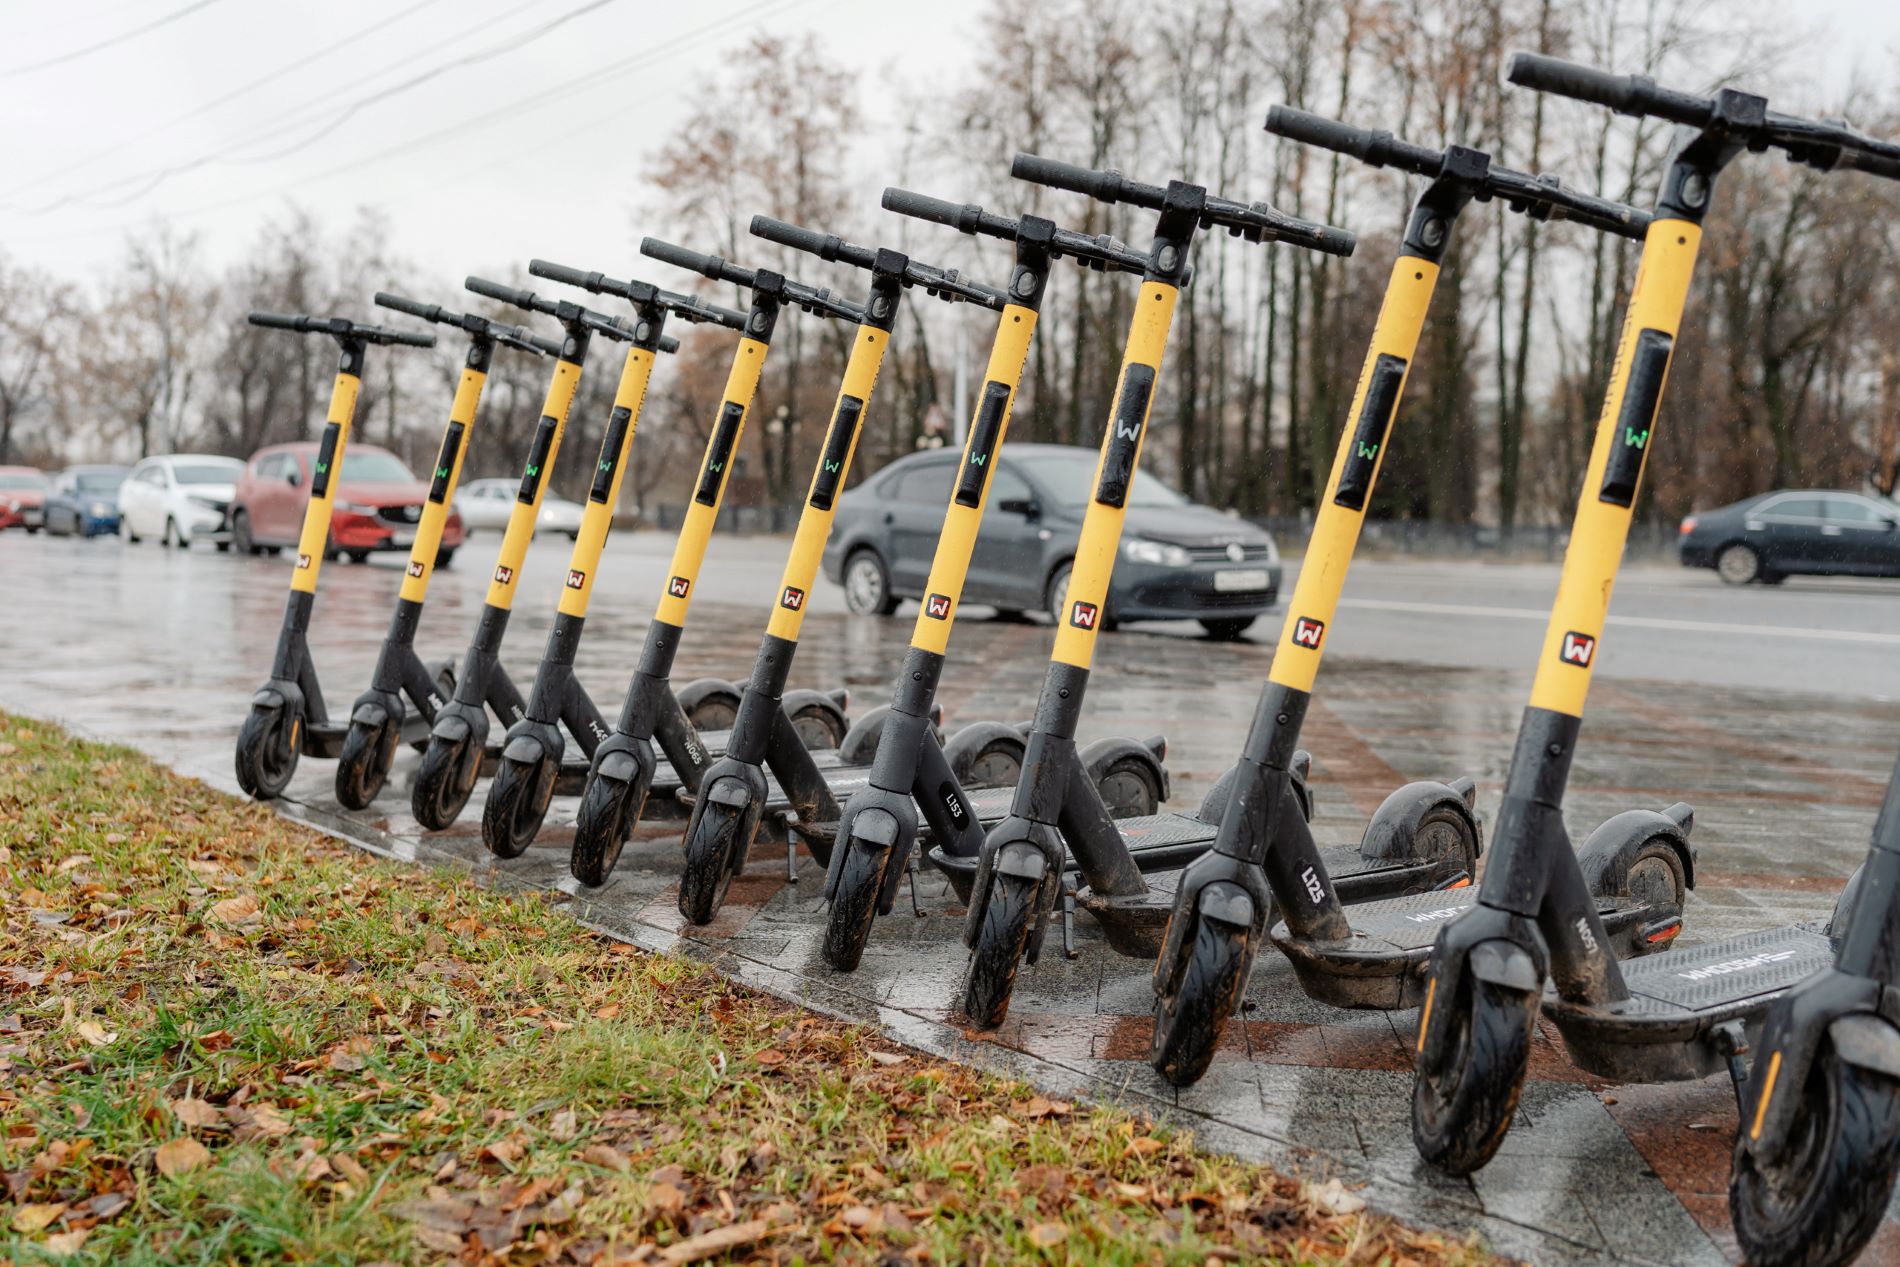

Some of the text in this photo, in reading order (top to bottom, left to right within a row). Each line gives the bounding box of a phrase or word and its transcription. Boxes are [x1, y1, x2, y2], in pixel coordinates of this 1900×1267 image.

[1117, 419, 1140, 441] W
[1625, 427, 1648, 449] W
[971, 451, 986, 466] W
[1358, 441, 1378, 460] W
[525, 463, 538, 476] W
[600, 459, 612, 472] W
[710, 460, 722, 472] W
[825, 459, 839, 473] W
[497, 566, 511, 582] W
[568, 571, 583, 587] W
[671, 579, 687, 595] W
[784, 590, 802, 607] W
[929, 597, 948, 616] W
[1074, 604, 1096, 626] W
[1297, 620, 1322, 644] W
[1565, 634, 1593, 663] W
[684, 741, 702, 765] N065
[946, 793, 962, 817] L153
[1301, 866, 1325, 904] L125
